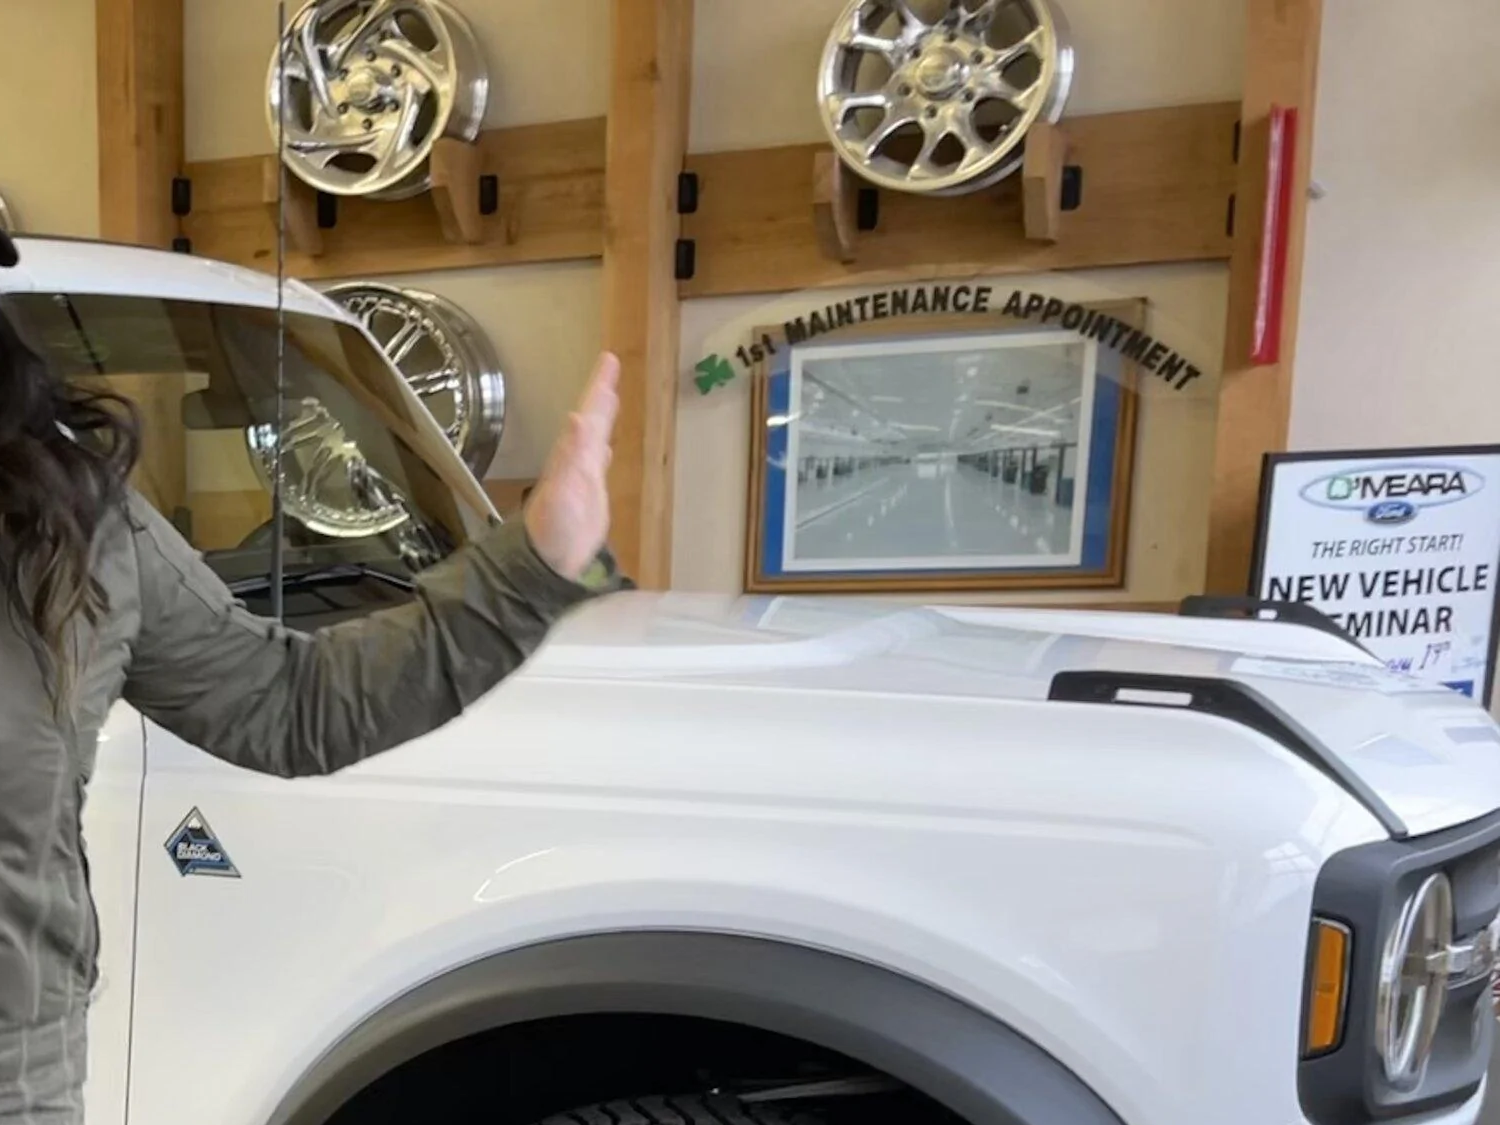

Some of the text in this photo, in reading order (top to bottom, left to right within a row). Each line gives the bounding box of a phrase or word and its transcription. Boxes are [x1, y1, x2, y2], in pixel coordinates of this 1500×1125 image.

[734, 286, 1203, 391] 1st MAINTENANCE APPOINTMENT
[1326, 471, 1467, 500] O'MEARA
[1312, 533, 1464, 559] THE RIGHT START!
[1268, 564, 1489, 602] NEW VEHICLE
[1331, 605, 1453, 638] MINAR
